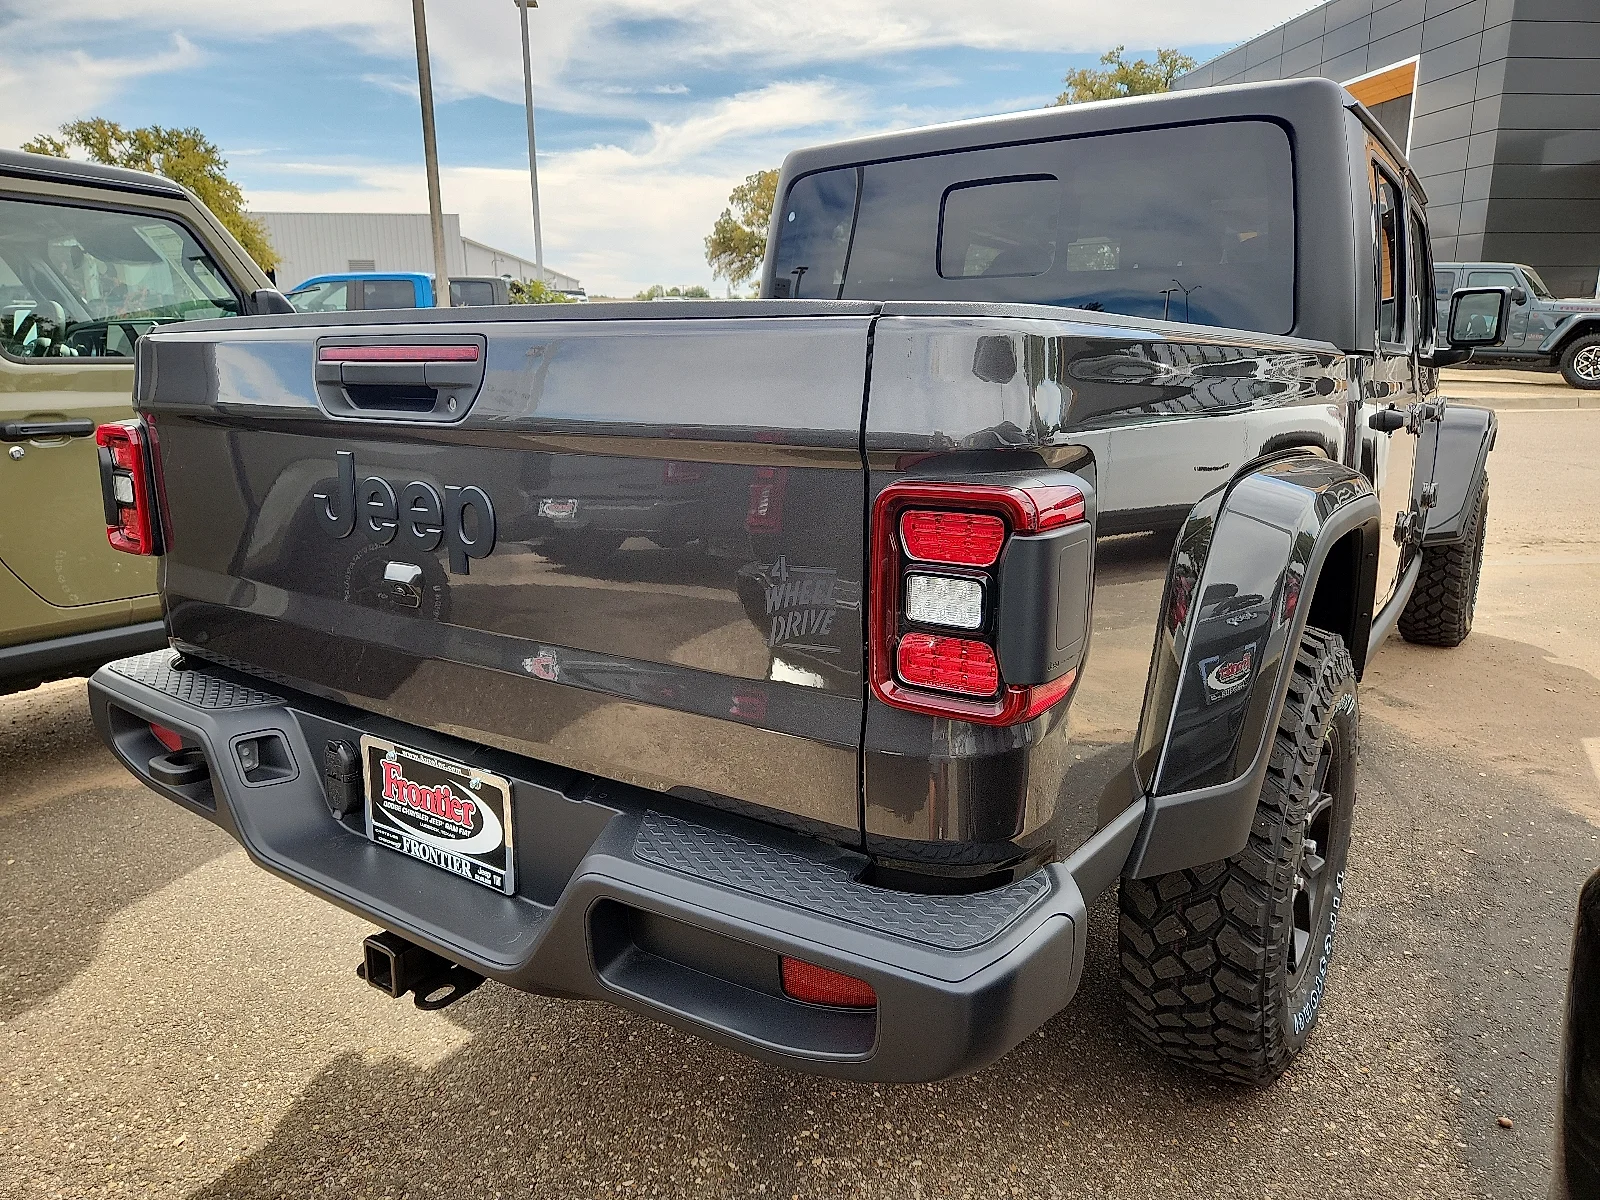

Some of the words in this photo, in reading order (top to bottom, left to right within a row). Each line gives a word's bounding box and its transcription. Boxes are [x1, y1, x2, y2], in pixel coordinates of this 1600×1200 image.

[314, 450, 496, 575] Jeep
[771, 555, 789, 581] 4
[765, 580, 836, 615] WHEEL
[768, 608, 836, 647] DRIVE
[381, 760, 476, 828] Frontier
[402, 805, 429, 822] CHRYSLER
[445, 821, 458, 833] RAM
[402, 835, 472, 879] FRONTIER
